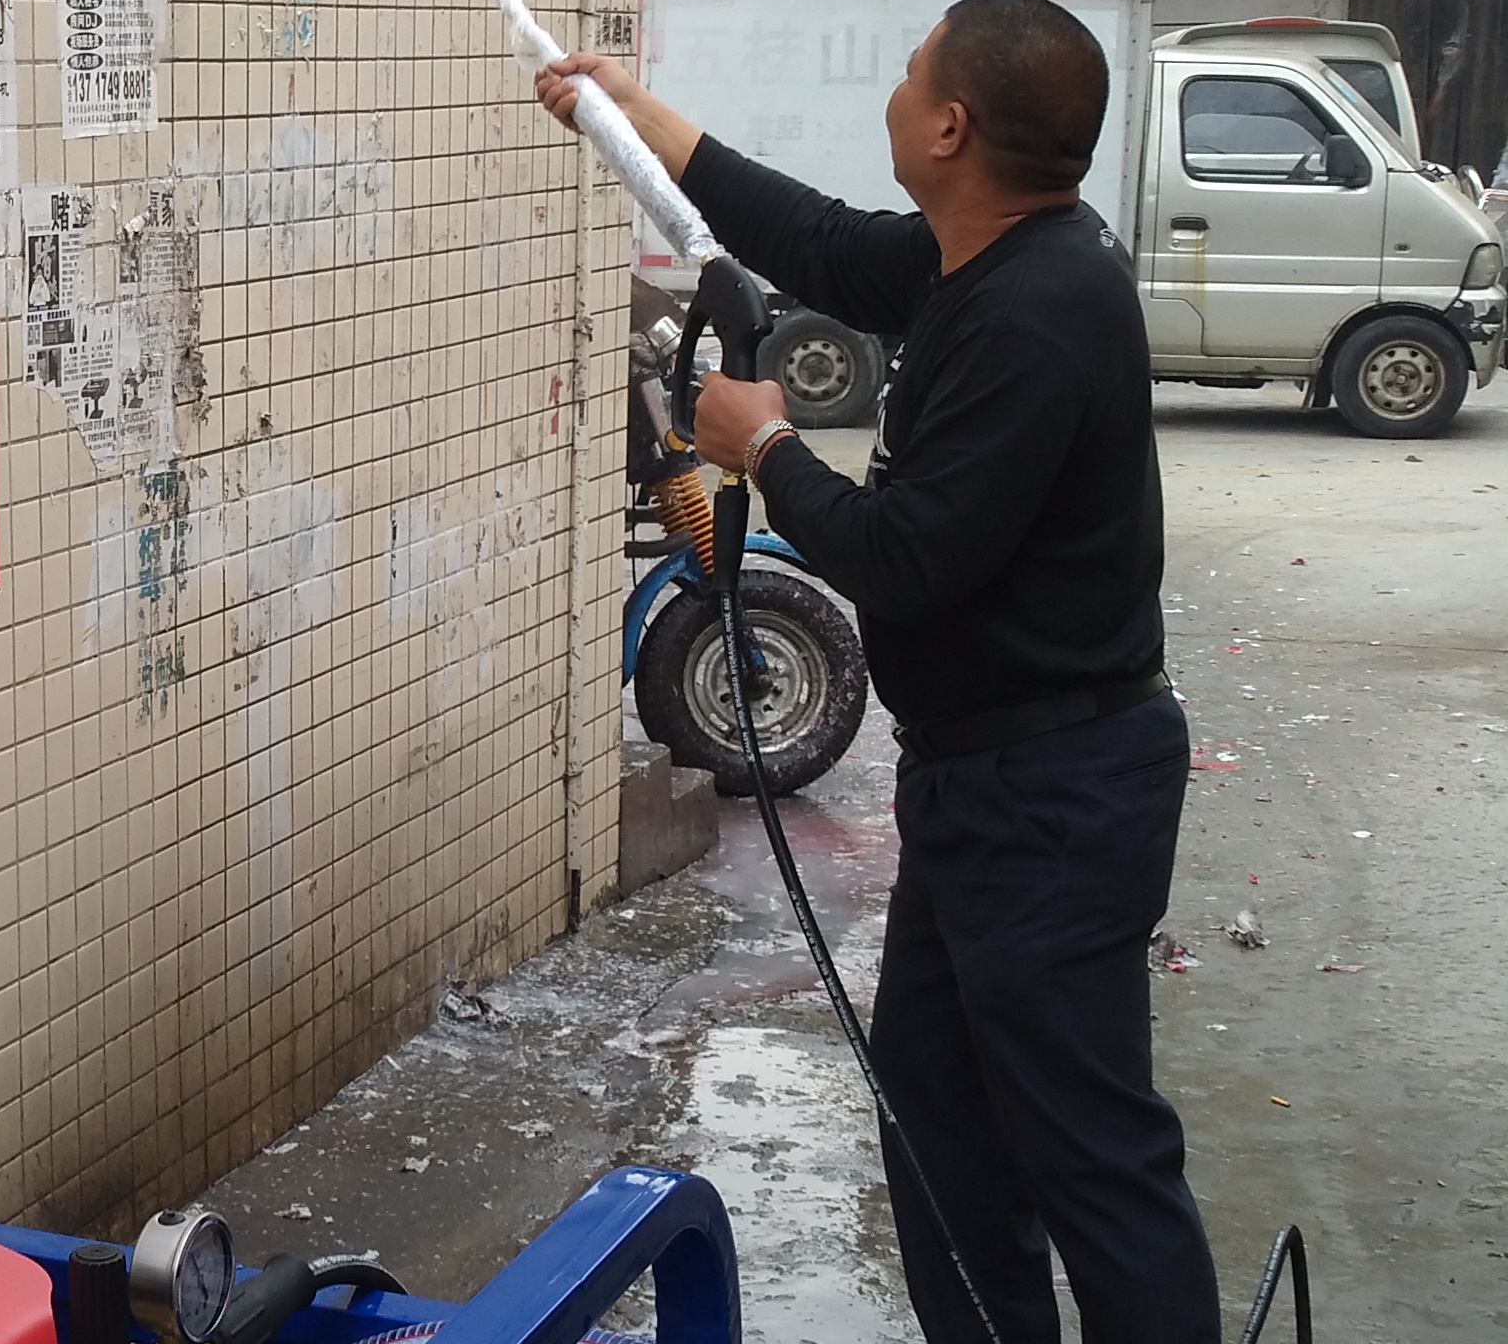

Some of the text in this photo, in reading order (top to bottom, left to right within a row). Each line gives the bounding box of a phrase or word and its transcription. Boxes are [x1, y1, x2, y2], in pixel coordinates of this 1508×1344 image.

[73, 69, 146, 103] 137 1749 8881
